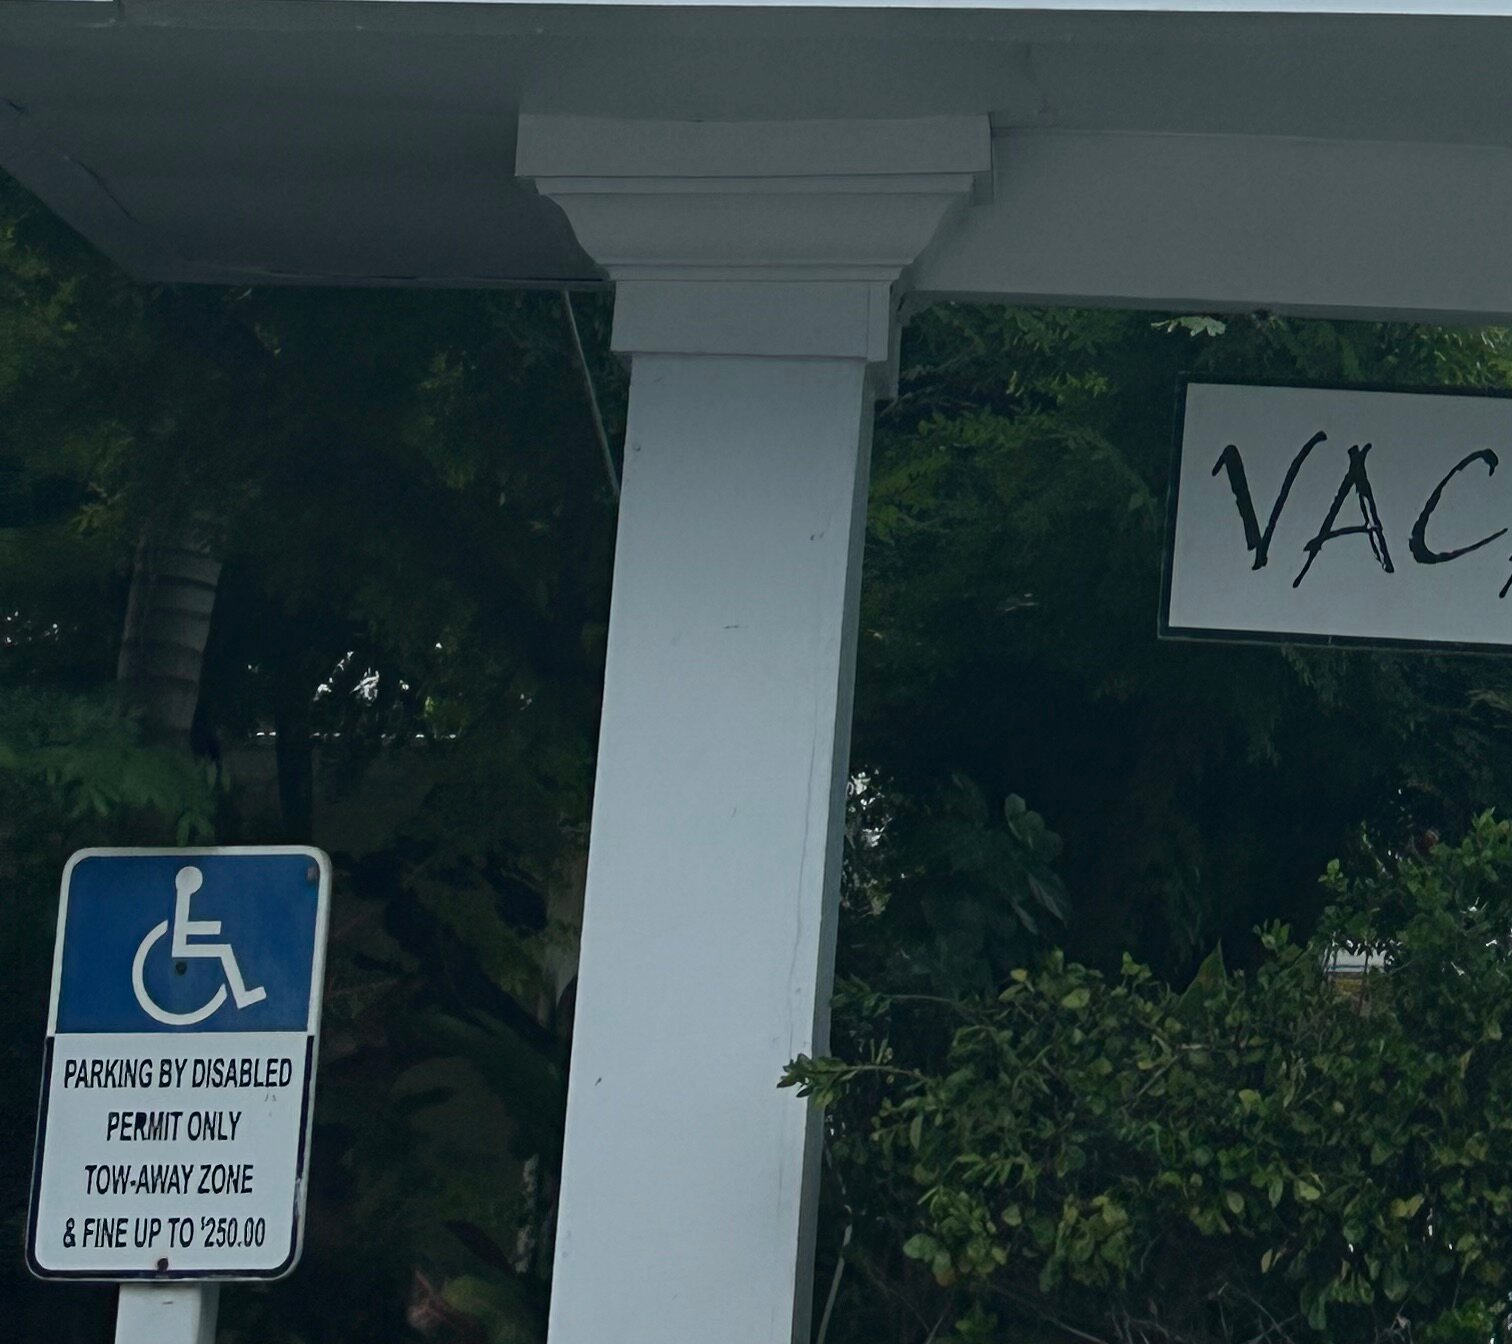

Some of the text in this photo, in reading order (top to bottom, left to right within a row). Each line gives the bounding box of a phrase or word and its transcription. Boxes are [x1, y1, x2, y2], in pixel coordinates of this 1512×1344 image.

[64, 1058, 293, 1088] PARKING BY DISABLED
[106, 1111, 242, 1142] PERMIT ONLY
[84, 1164, 254, 1195] TOW-AWAY ZONE
[62, 1217, 77, 1248] &
[82, 1218, 129, 1248] FINE
[133, 1217, 162, 1248] UP
[168, 1217, 195, 1248] TO
